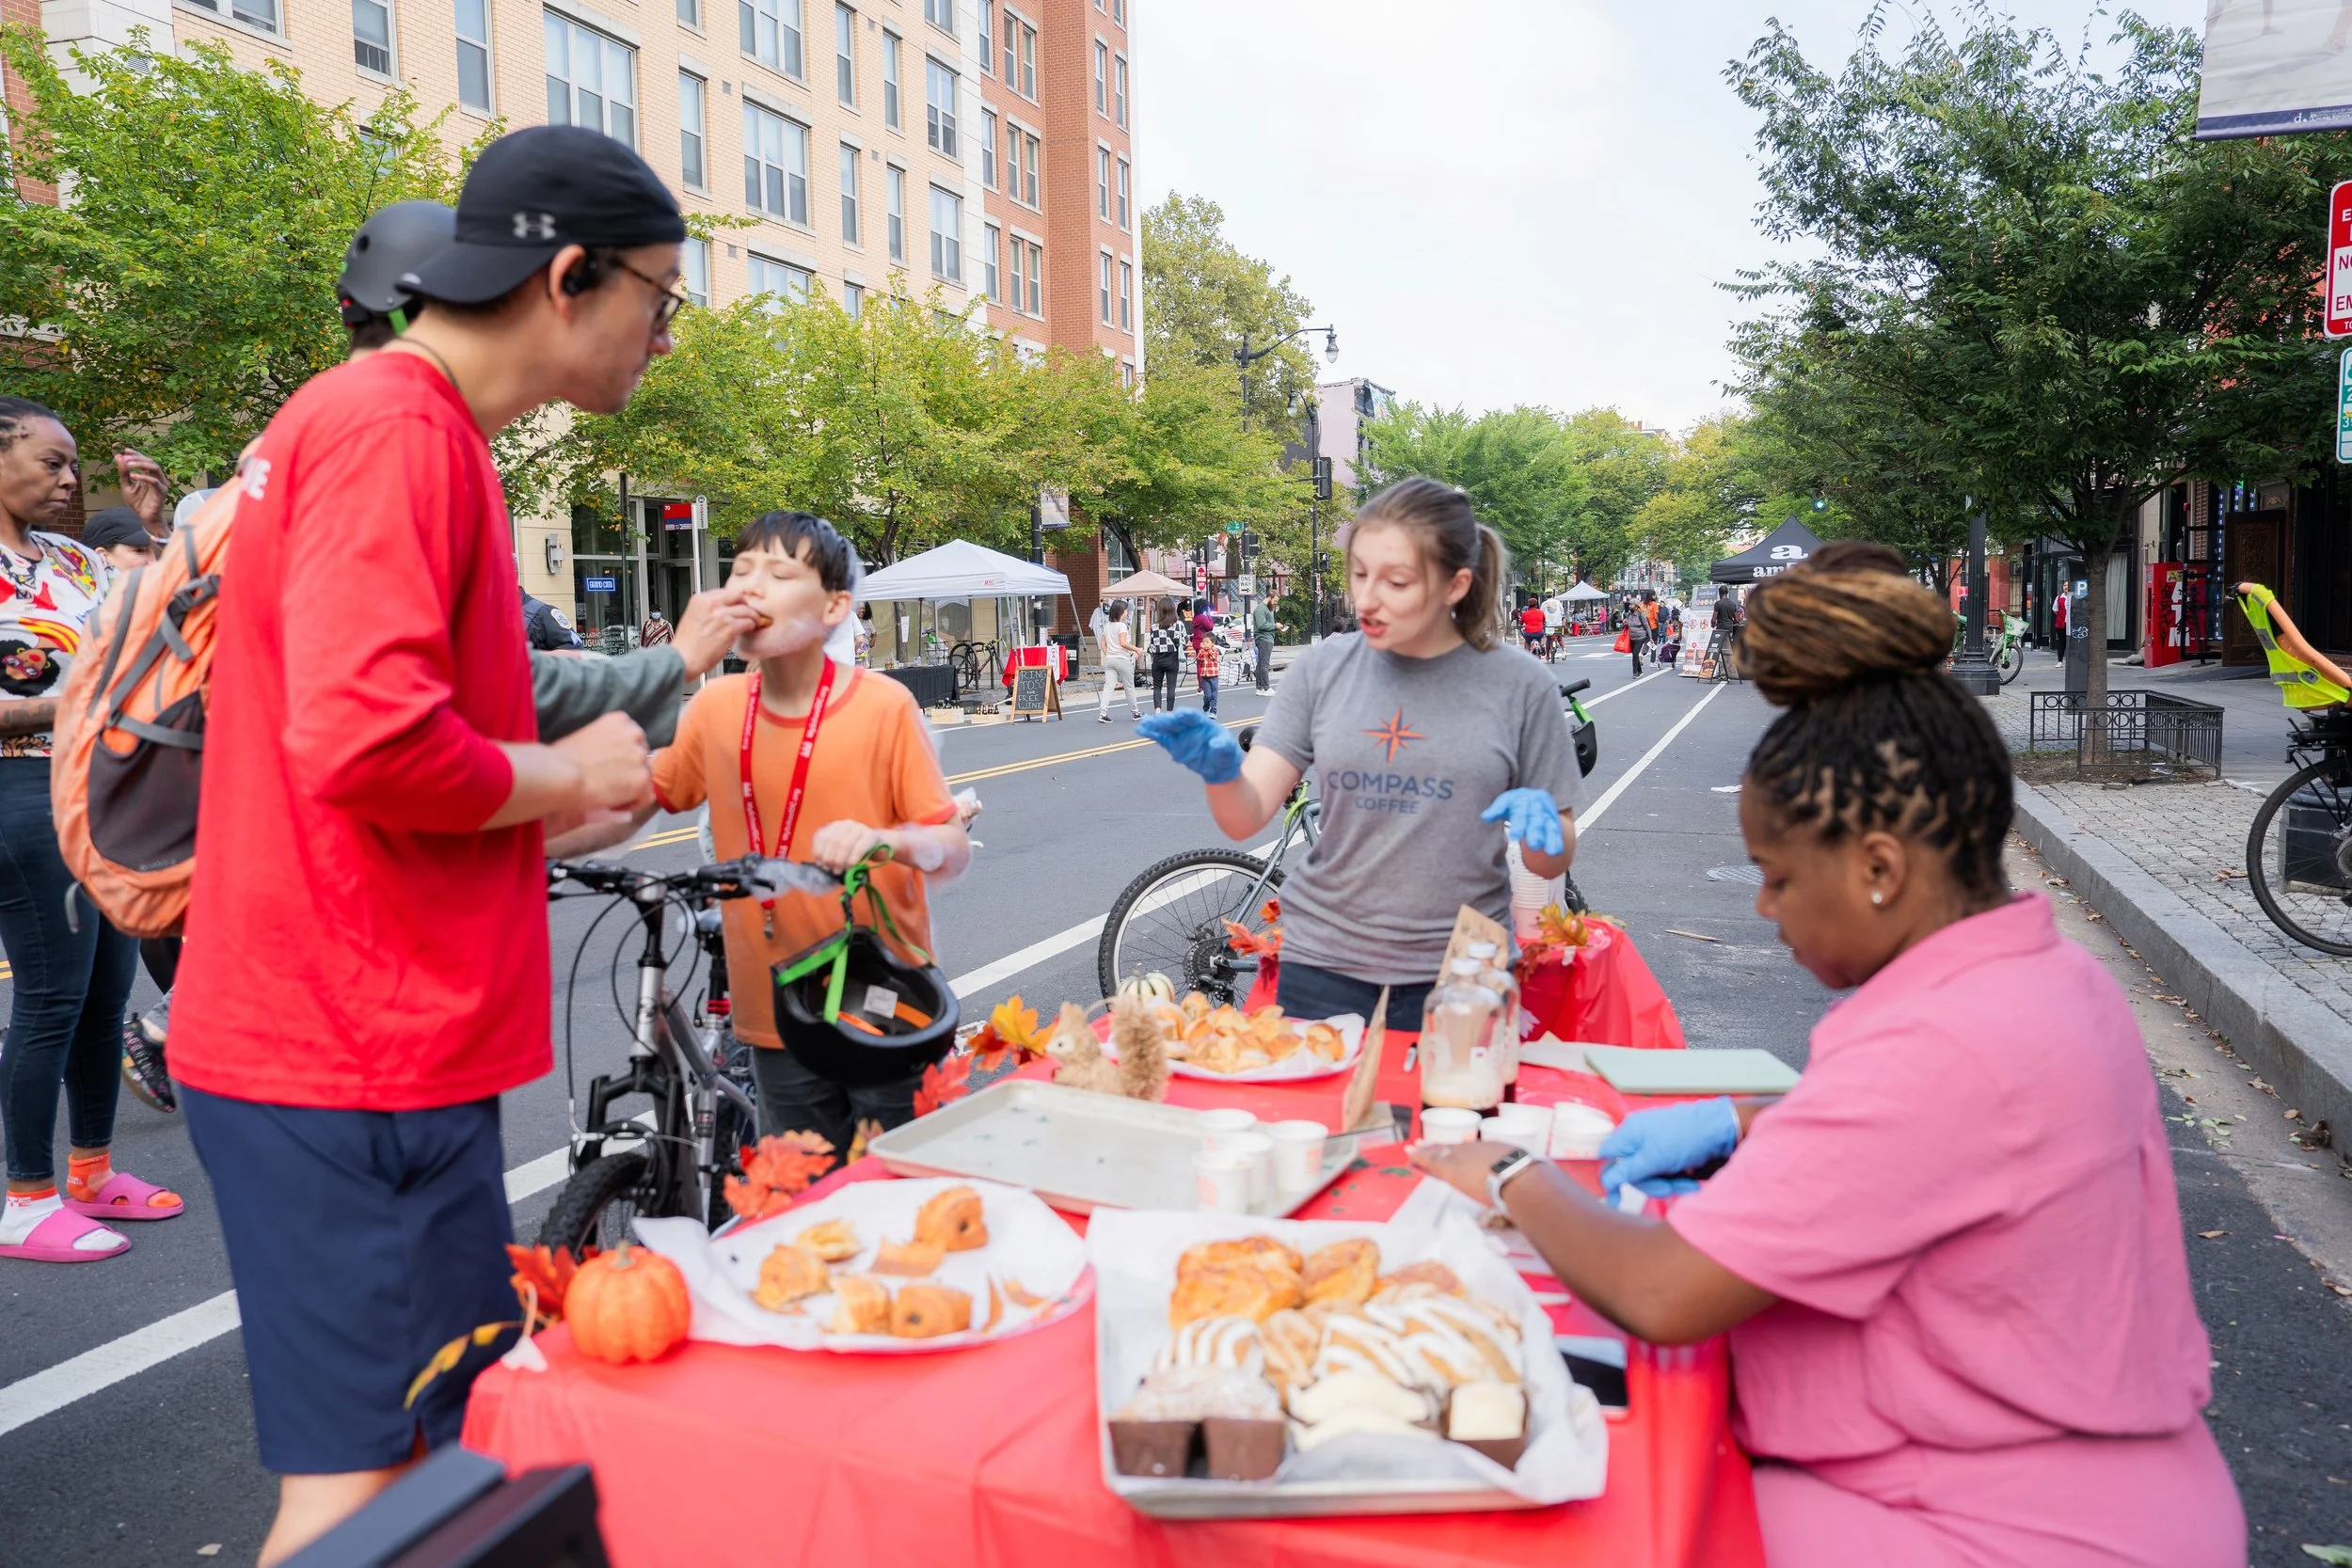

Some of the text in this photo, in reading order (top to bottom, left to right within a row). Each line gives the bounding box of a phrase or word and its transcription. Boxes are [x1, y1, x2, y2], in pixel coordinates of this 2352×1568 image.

[2077, 581, 2088, 595] P
[1021, 670, 1046, 680] RING
[1020, 679, 1045, 690] TOSS
[1018, 694, 1040, 703] FREE
[1327, 770, 1454, 800] COMPASS
[1355, 796, 1420, 815] COFFEE
